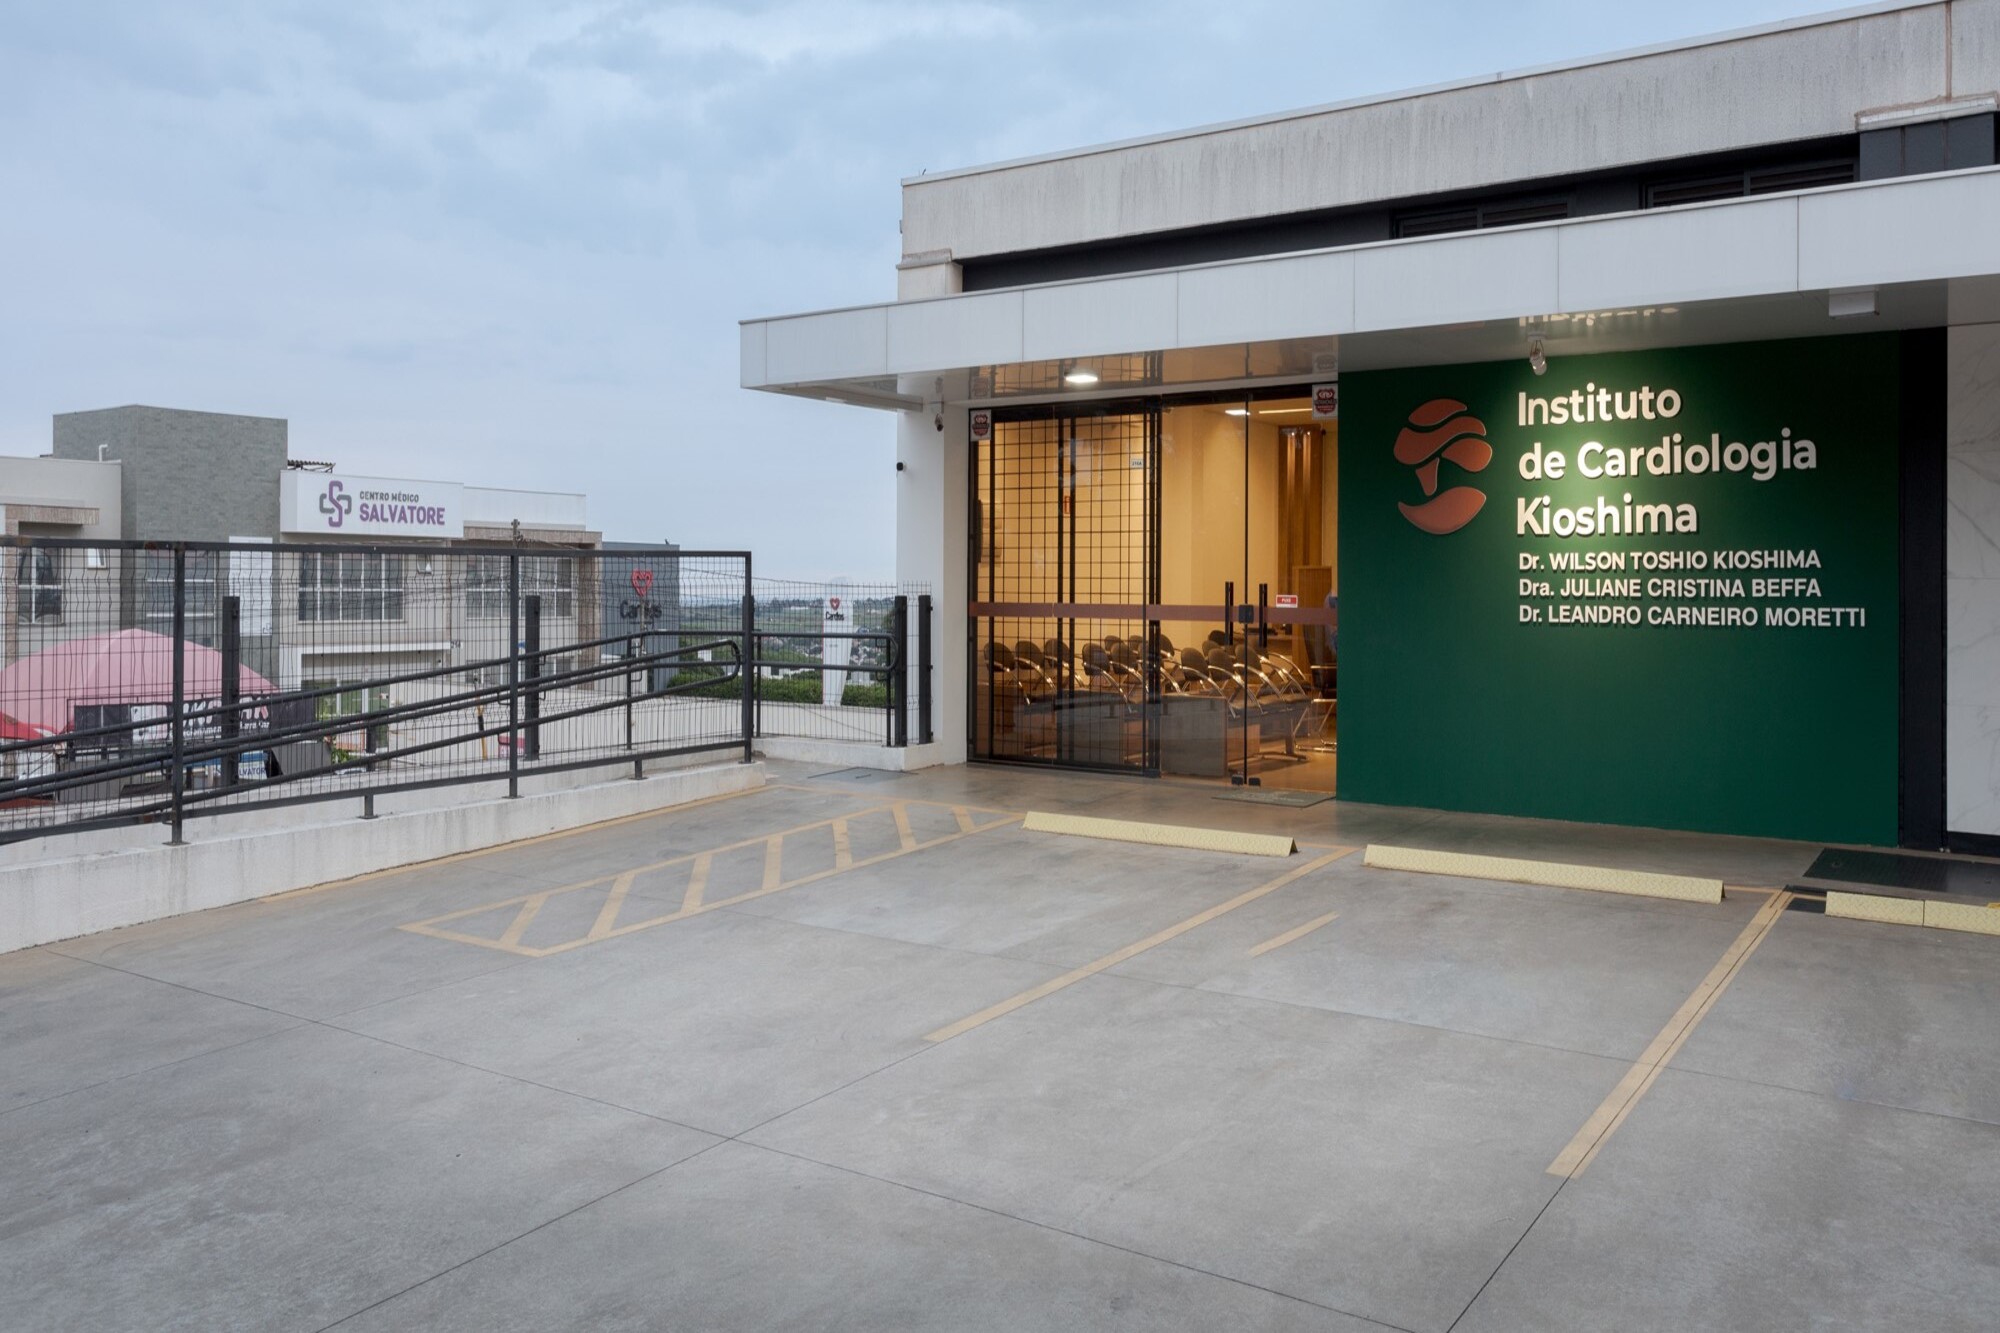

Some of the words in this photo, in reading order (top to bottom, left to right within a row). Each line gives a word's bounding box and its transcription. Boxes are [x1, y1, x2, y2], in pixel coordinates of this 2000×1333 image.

[1518, 382, 1682, 427] Instituto
[1518, 441, 1567, 481] de
[1577, 427, 1819, 482] Cardiologia
[359, 490, 389, 501] CENTRO
[391, 490, 419, 503] MÉDICO
[359, 502, 446, 526] SALVATORE
[1517, 492, 1699, 538] Kioshima
[1518, 552, 1545, 571] Dr.
[1549, 551, 1626, 571] WILSON
[1630, 551, 1708, 571] TOSHIO
[1713, 549, 1822, 570] KIOSHIMA
[1518, 578, 1555, 597] Dra.
[1560, 578, 1642, 598] JULIANE
[1647, 578, 1746, 599] CRISTINA
[1751, 578, 1822, 598] BEFFA
[1518, 605, 1543, 624] Dr.
[1548, 605, 1642, 625] LEANDRO
[1647, 607, 1759, 627] CARNEIRO
[1764, 607, 1866, 628] MORETTI
